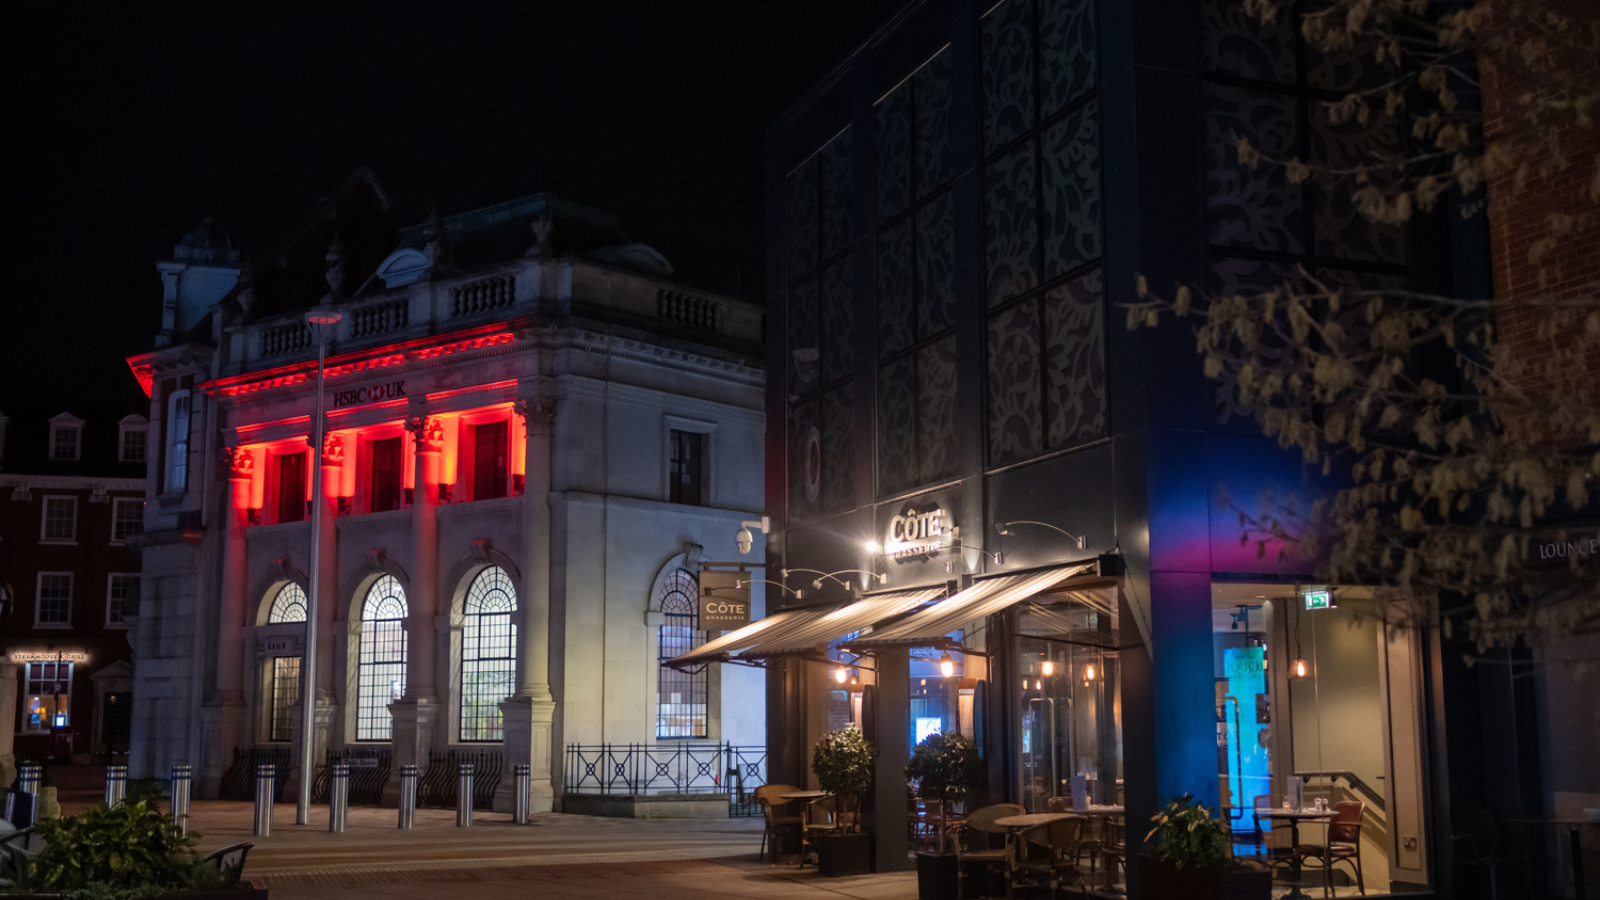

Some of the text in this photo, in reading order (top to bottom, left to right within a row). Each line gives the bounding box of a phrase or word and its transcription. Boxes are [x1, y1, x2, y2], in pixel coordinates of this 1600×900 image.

[334, 381, 406, 407] HSBC UK
[891, 508, 943, 543] CÔTE
[706, 601, 745, 614] CÔTE
